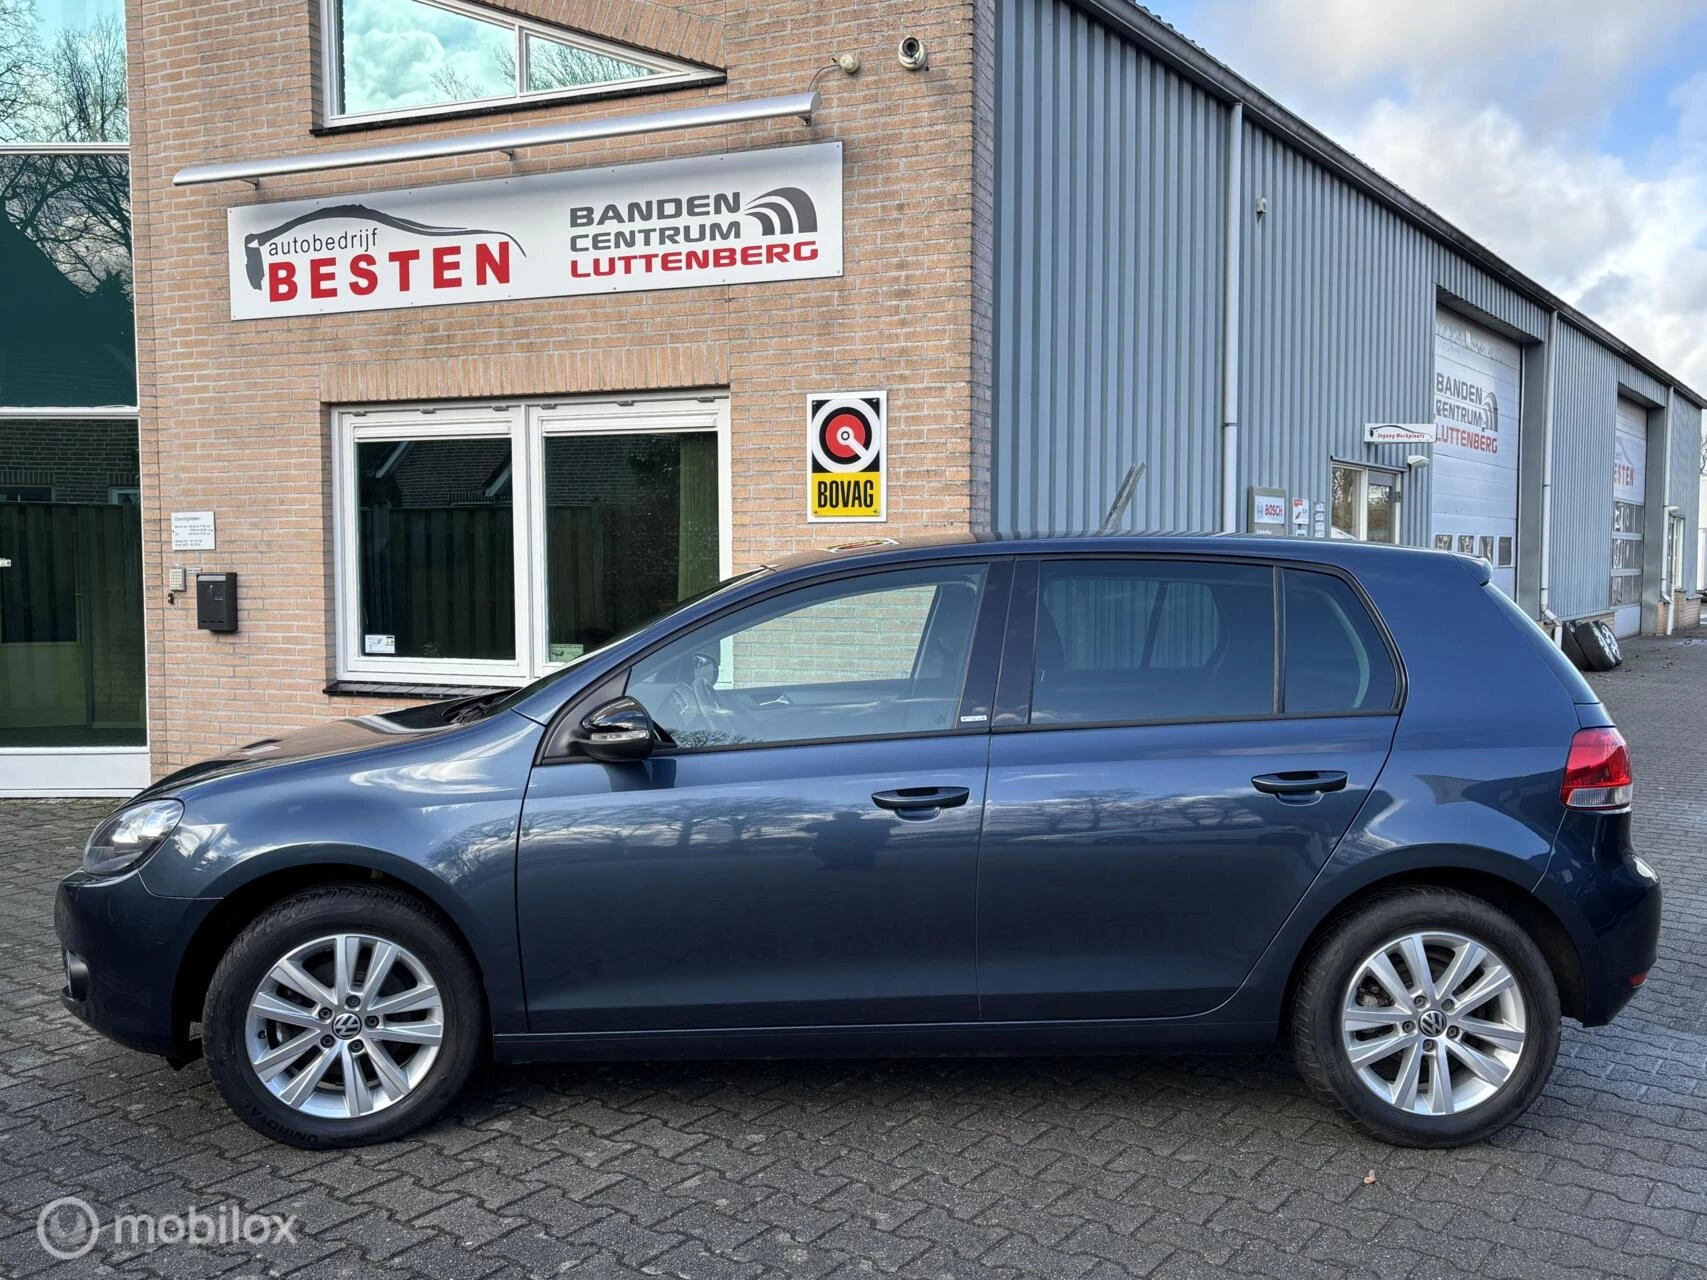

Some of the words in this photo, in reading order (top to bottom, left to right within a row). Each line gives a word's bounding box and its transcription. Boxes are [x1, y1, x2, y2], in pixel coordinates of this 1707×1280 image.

[570, 192, 741, 228] BANDEN
[269, 228, 379, 256] autobedrijf
[570, 220, 741, 252] CENTRUM
[268, 241, 510, 302] BESTEN
[570, 241, 819, 278] LUTTENBERG
[1436, 372, 1482, 405] BANDEN
[1436, 400, 1483, 427] CENTRUM
[1436, 423, 1498, 454] LUTTENBERG
[817, 480, 874, 509] BOVAG
[1265, 504, 1283, 516] BOSCH
